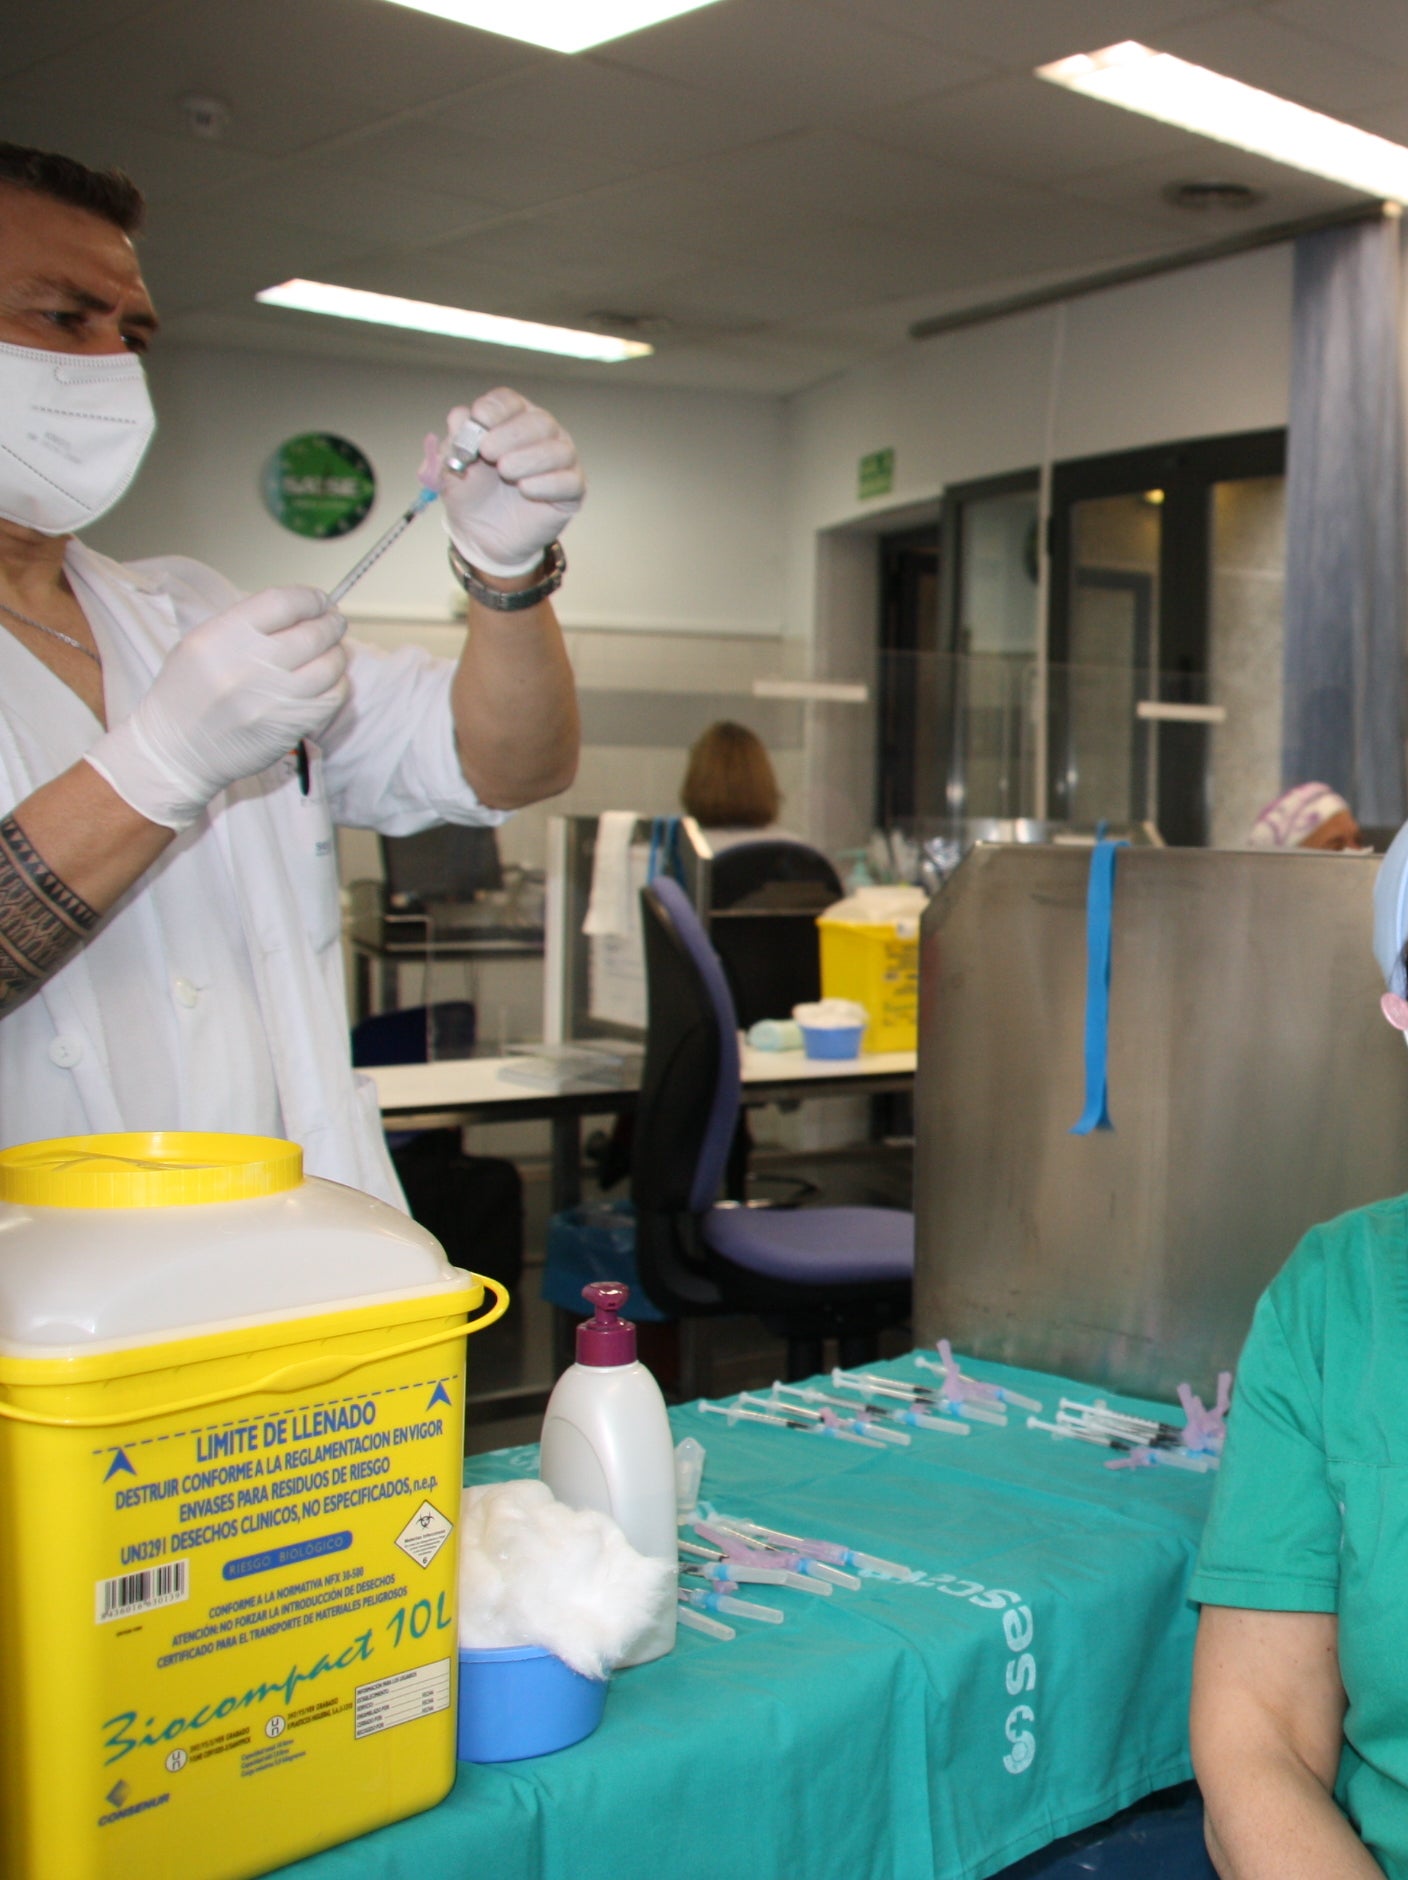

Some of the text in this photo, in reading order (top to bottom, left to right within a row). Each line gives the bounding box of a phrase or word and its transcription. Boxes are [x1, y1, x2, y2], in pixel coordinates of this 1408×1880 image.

[116, 1419, 442, 1509] DESTRUIR CONFORME A LA REGLAMENTACION EN VIGOR
[196, 1401, 376, 1462] LIMITE DE LLENADO
[121, 1475, 437, 1564] UN3291 DESECHOS CLINICOS, NO ESPECIFICADOS, n.e.p.
[180, 1457, 390, 1522] ENVASES PARA RESIDUOS DE RIESGO
[229, 1535, 343, 1578] RIESGO BIOLÓGICO
[157, 1587, 407, 1668] CERTIFICADO PARA EL TRANSPORTE DE MATERIALES PELIGROSOS
[172, 1573, 395, 1646] ATENCIÓN: NO FORZAR LA INTRODUCCIÓN DE DESECHOS
[209, 1597, 254, 1618] CONFORME
[264, 1592, 275, 1603] LA
[276, 1579, 322, 1600] NORMATIVA
[102, 1629, 374, 1766] Biocompact
